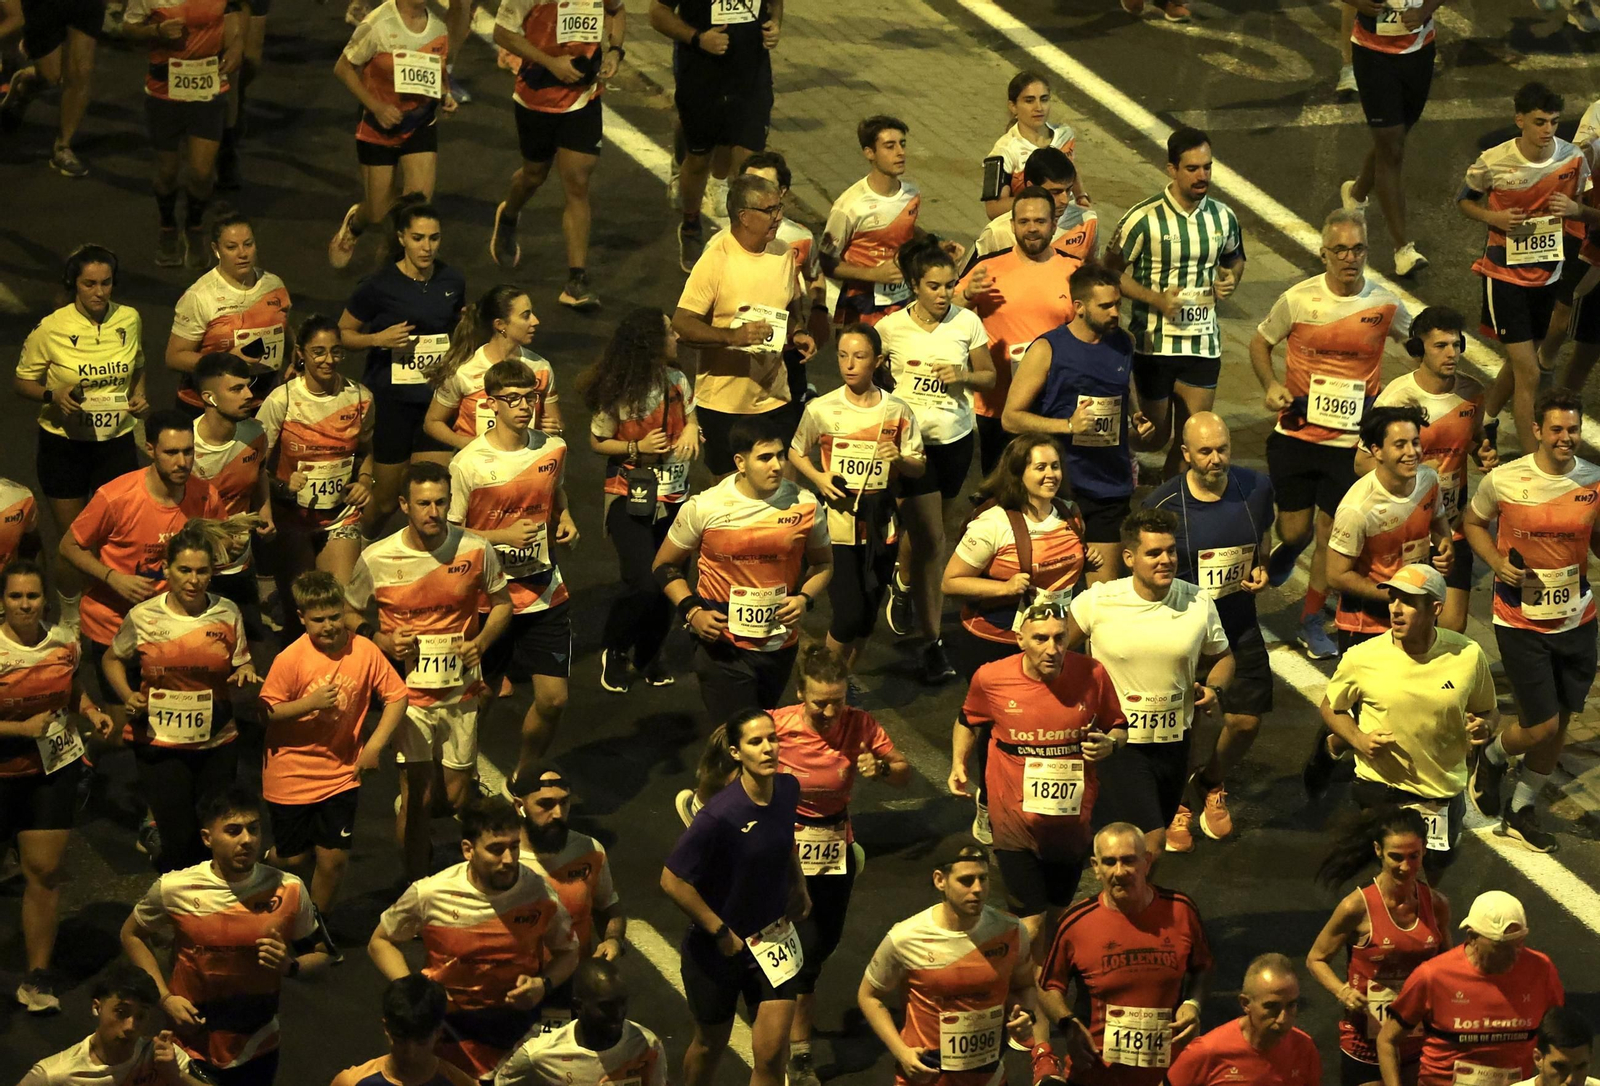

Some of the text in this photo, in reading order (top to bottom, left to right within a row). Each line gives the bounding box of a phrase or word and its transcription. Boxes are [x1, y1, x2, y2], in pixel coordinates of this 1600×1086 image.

[562, 16, 598, 31] 10662
[174, 75, 214, 91] 20520
[400, 68, 436, 86] 10663
[1513, 234, 1556, 251] 11885
[78, 361, 129, 378] Khalifa
[78, 376, 126, 390] Capita
[1315, 395, 1357, 415] 13969
[77, 412, 120, 429] 16821
[290, 441, 306, 454] 37
[838, 459, 883, 476] 18005
[309, 478, 343, 497] 1436
[1513, 528, 1576, 542] 37 NOCTURNA
[500, 543, 541, 565] 13027
[732, 554, 779, 562] NOCTURNA
[1206, 563, 1246, 586] 11451
[1533, 587, 1570, 606] 2169
[413, 655, 457, 674] 17114
[155, 710, 205, 729] 17116
[1130, 711, 1177, 729] 21518
[1009, 728, 1035, 741] Los
[1036, 748, 1046, 757] DE
[1046, 745, 1080, 757] ATLETISM
[1031, 781, 1078, 799] 18207
[767, 938, 797, 968] 3419
[1103, 953, 1127, 970] LOS
[1129, 952, 1178, 969] LENTOS
[1453, 1017, 1532, 1030] Los Lentos
[948, 1031, 995, 1054] 10996
[1112, 1029, 1164, 1052] 11814
[1459, 1032, 1529, 1044] CLUB DE ATLETISMO
